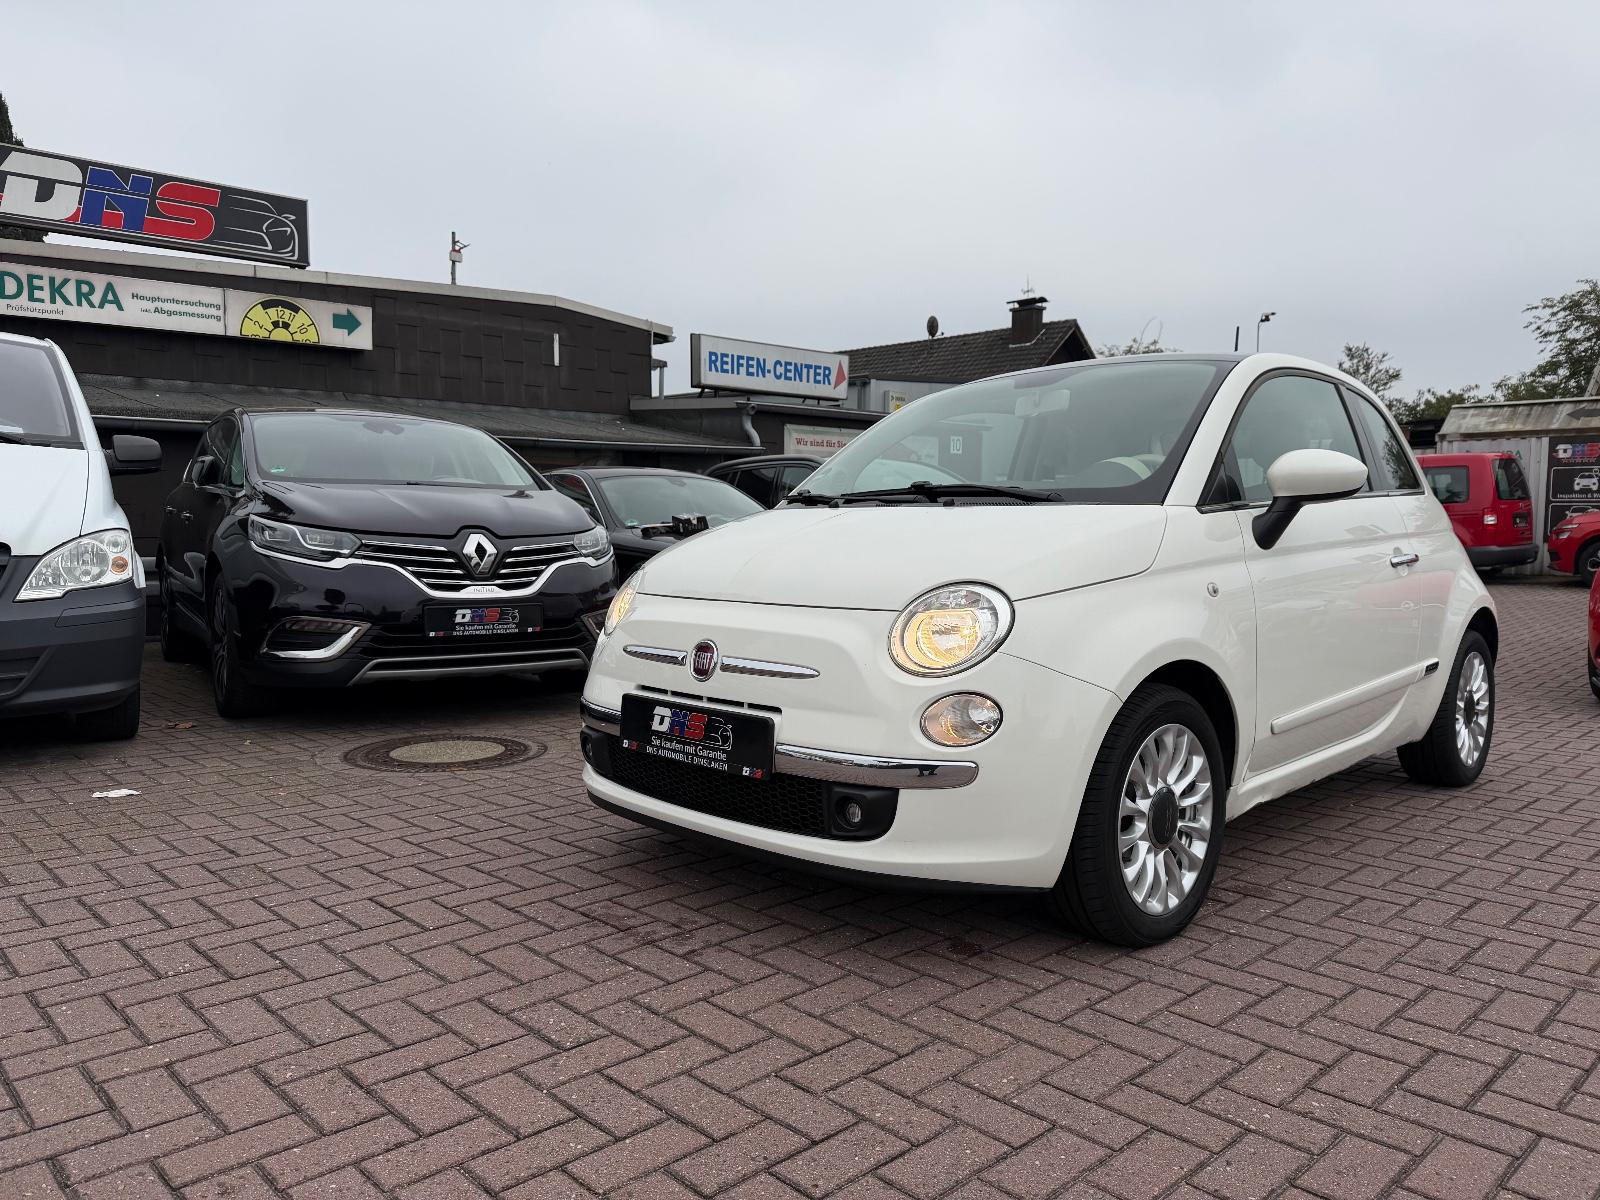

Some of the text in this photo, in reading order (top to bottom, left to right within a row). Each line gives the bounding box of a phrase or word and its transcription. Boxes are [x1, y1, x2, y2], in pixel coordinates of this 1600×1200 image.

[0, 150, 221, 242] DNS
[0, 270, 124, 312] DEKRA
[6, 303, 64, 316] Prüfstützpunkt
[131, 292, 221, 311] Hauptuntersuchung
[153, 307, 221, 322] Abgasmessung
[275, 309, 286, 320] 12
[287, 312, 296, 323] 11
[253, 320, 264, 330] 2
[297, 322, 309, 335] 10
[708, 351, 832, 386] REIFEN-CENTER
[795, 437, 808, 446] Wir
[810, 439, 825, 448] sind
[826, 439, 836, 448] für
[951, 437, 962, 453] 10
[455, 608, 501, 623] DNS
[695, 652, 713, 670] FIAT
[651, 705, 708, 740] DNS
[651, 735, 661, 747] Sie
[661, 738, 684, 752] kaufen
[684, 744, 696, 755] mit
[696, 746, 727, 761] Garantie
[646, 745, 728, 771] DNS AUTOMOBILE DINSLAKEN
